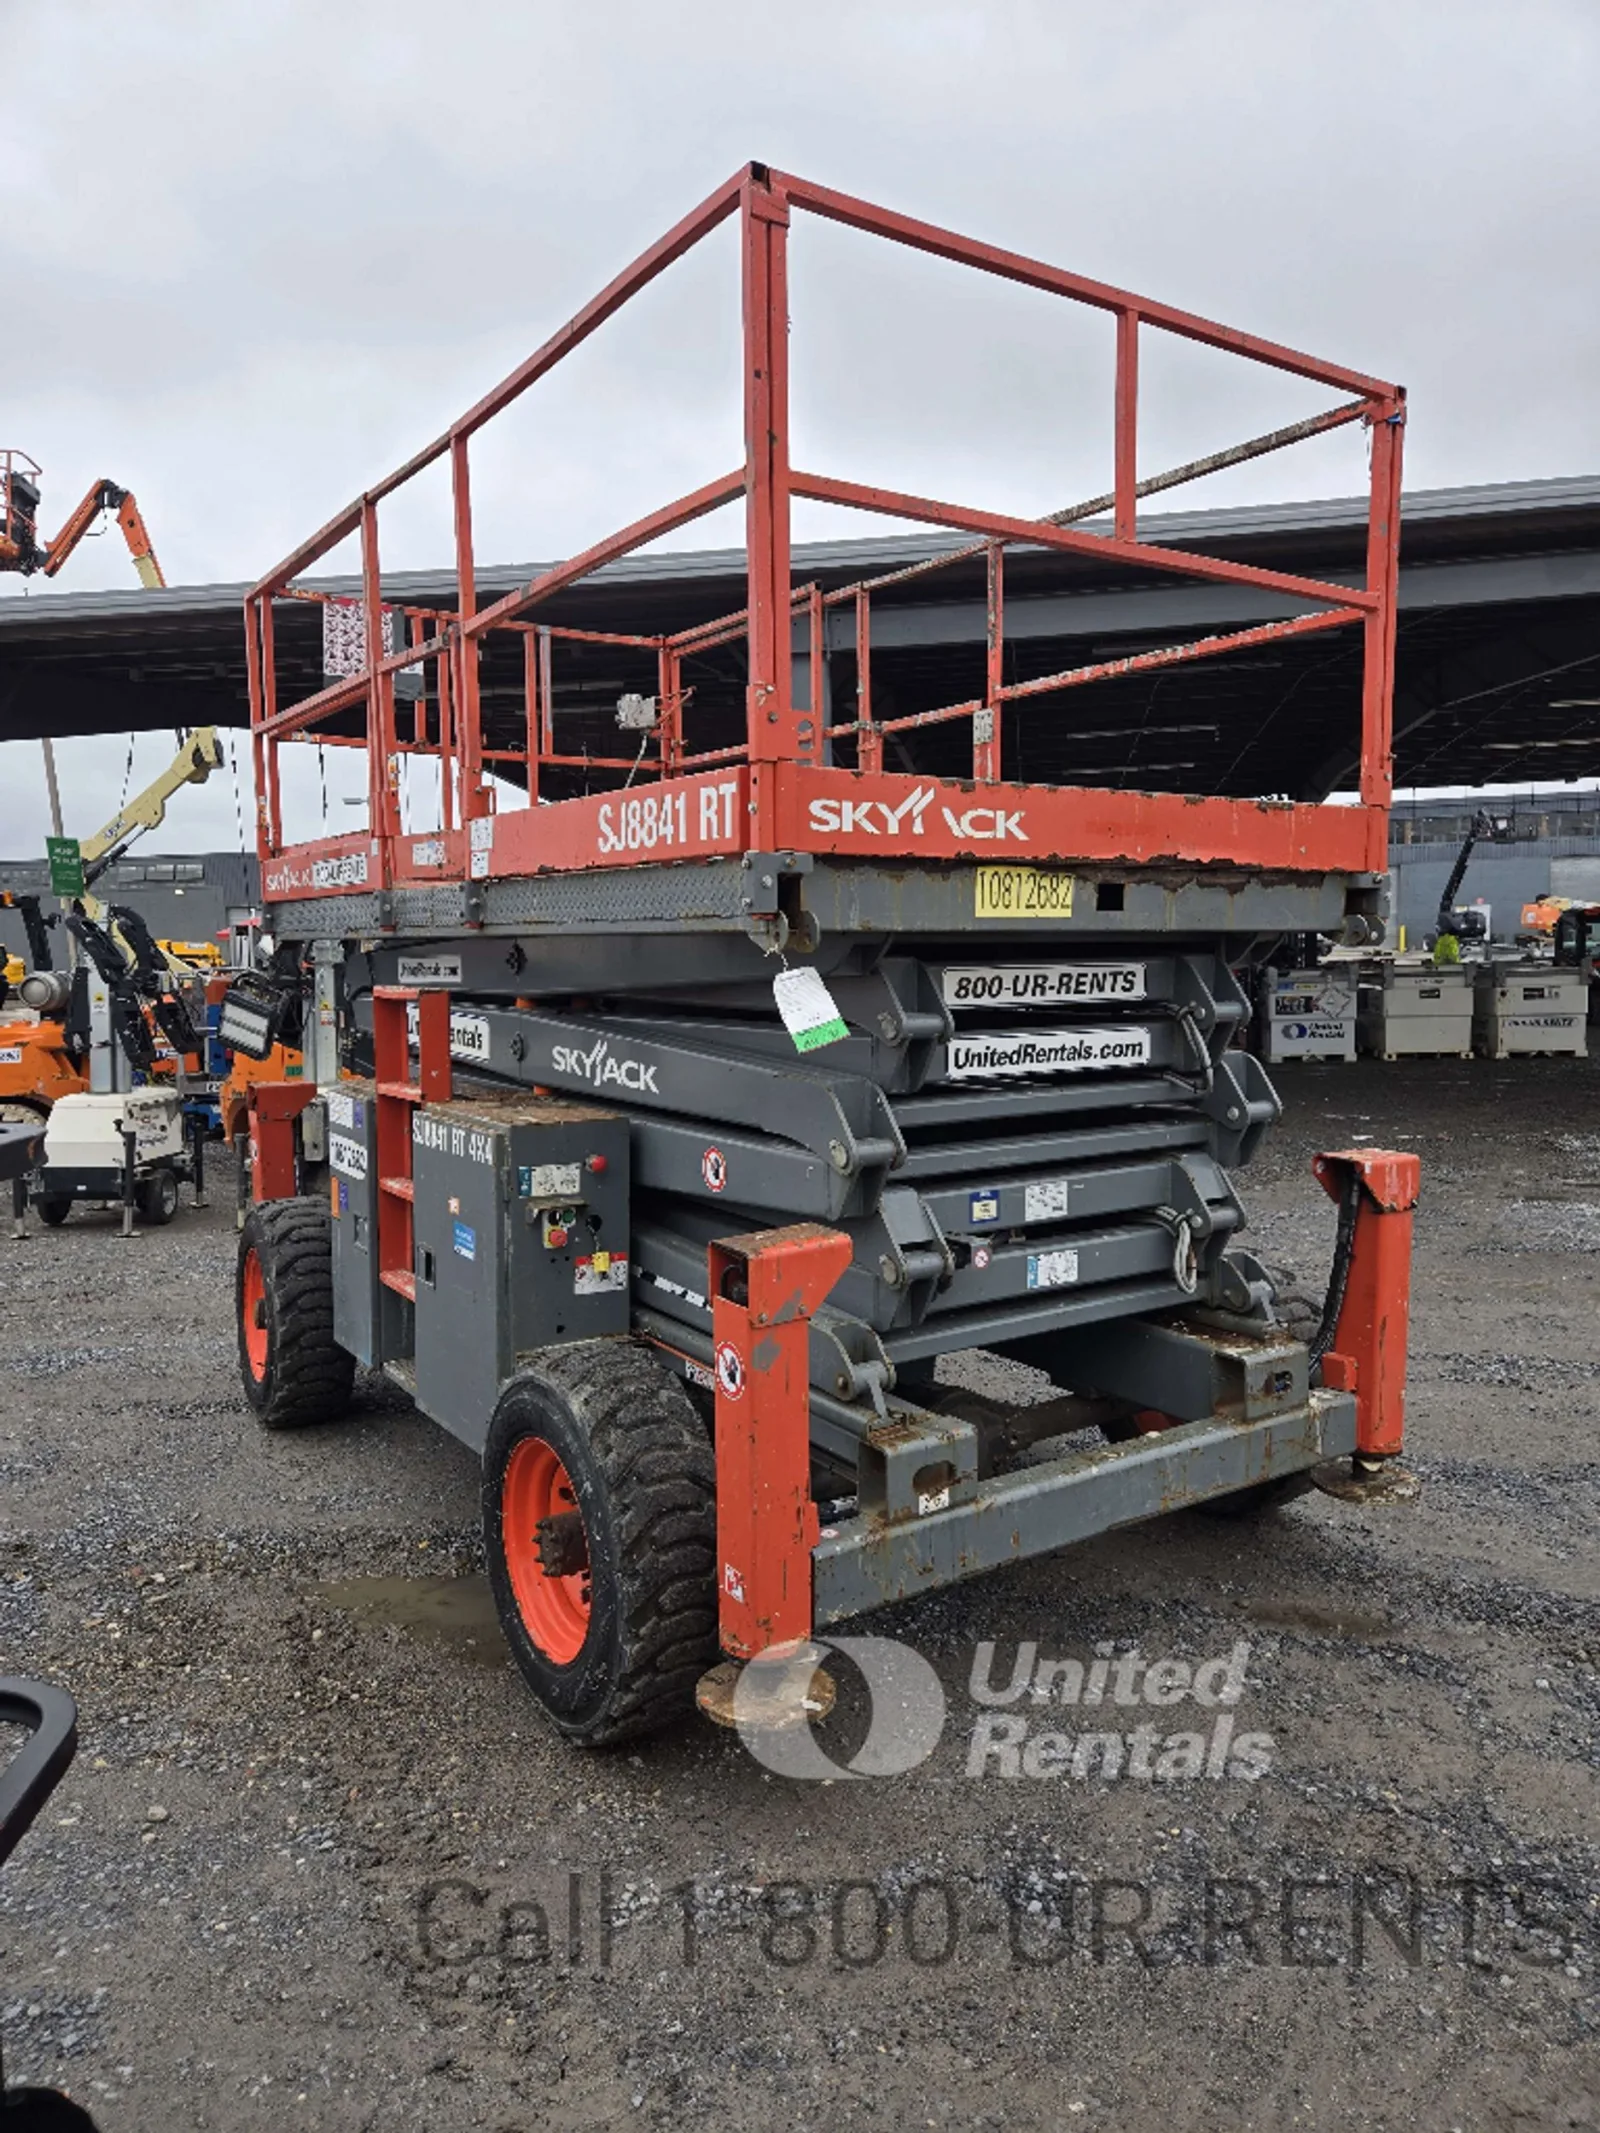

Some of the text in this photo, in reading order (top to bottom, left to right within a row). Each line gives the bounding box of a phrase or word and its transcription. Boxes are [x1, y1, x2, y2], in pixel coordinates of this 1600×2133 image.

[598, 782, 737, 853] SJ8841 RT
[978, 872, 1073, 910] 10812682
[954, 970, 1137, 999] 800-UR-RENTS
[552, 1038, 660, 1095] SKYJACK
[954, 1039, 1143, 1069] UnitedRentals.com
[452, 1127, 466, 1157] RT
